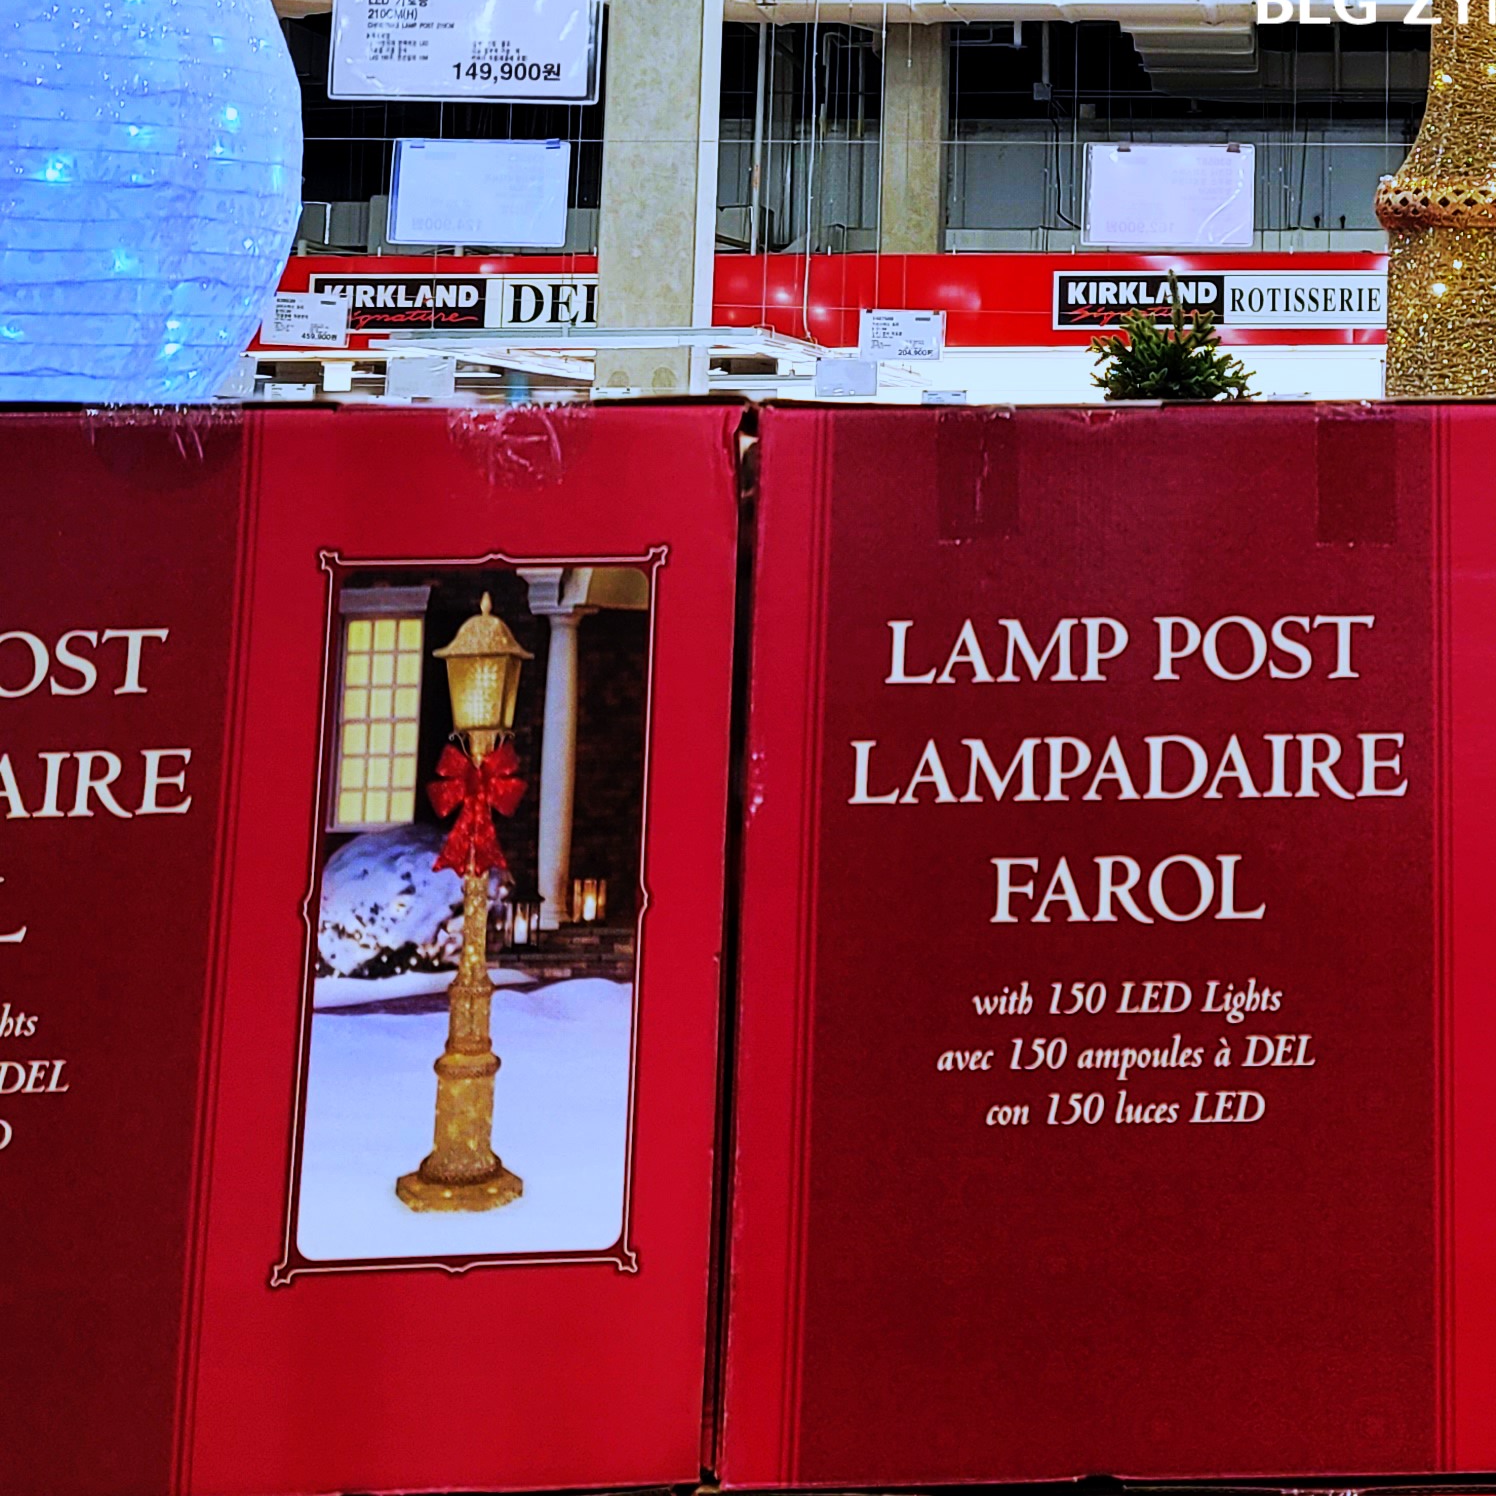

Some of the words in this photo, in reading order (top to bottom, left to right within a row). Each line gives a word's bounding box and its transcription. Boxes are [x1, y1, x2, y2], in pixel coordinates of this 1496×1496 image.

[452, 62, 561, 84] 149,900원
[350, 310, 478, 330] ignature
[1068, 281, 1217, 304] KIRKLAND
[1230, 287, 1381, 313] ROTISSERIE
[885, 616, 1130, 685] LAMP
[1152, 614, 1375, 681] POST
[848, 731, 1409, 805] LAMPADAIRE
[989, 853, 1266, 924] FAROL
[971, 981, 1034, 1016] with
[1049, 982, 1107, 1015] 150
[1116, 980, 1192, 1014] LED
[1201, 977, 1282, 1024] Lights
[937, 1048, 995, 1071] avec
[1009, 1037, 1068, 1070] 150
[1076, 1033, 1204, 1081] ampoules
[1213, 1037, 1231, 1068] à
[1241, 1034, 1316, 1068] DEL
[985, 1102, 1030, 1126] con
[1046, 1093, 1105, 1125] 150
[1114, 1089, 1180, 1125] luces
[1189, 1091, 1266, 1123] LED
